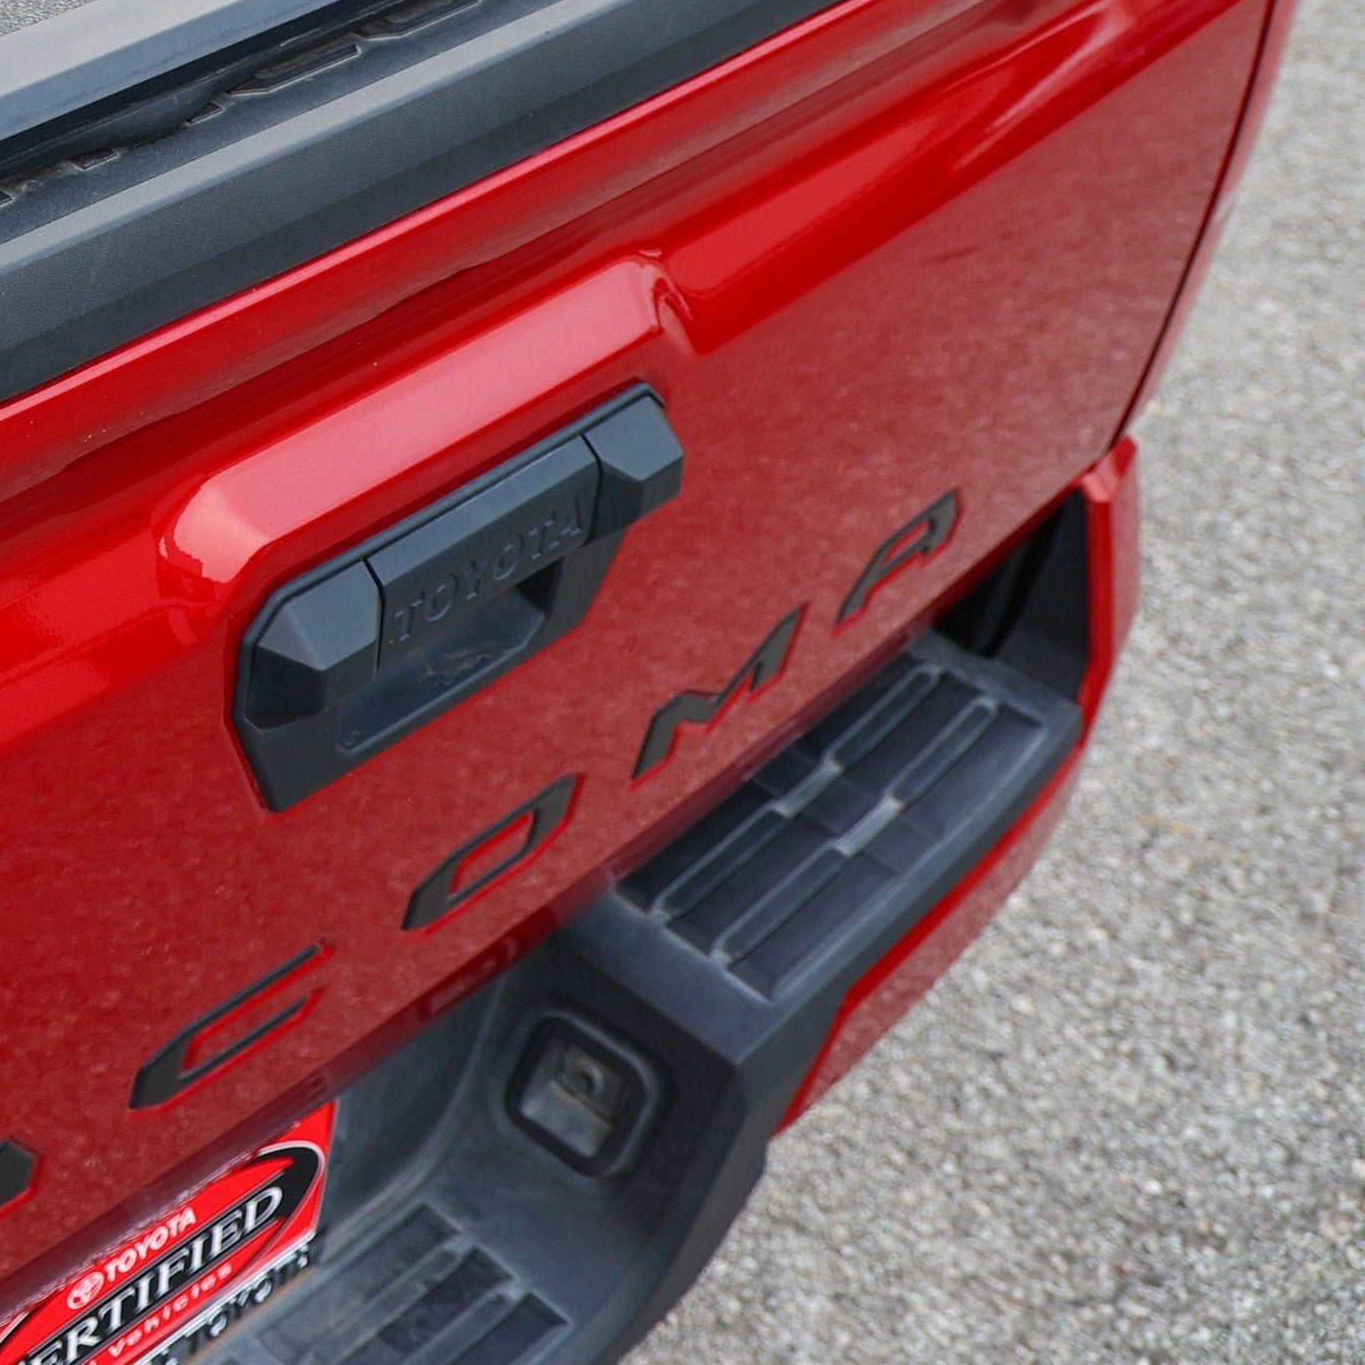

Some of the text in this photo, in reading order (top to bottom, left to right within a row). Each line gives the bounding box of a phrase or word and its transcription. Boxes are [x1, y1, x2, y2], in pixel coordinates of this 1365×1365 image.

[394, 498, 584, 642] TOYOTA
[17, 1186, 283, 1365] ERTIFIED
[104, 1206, 197, 1283] TOYOTA
[107, 1262, 233, 1358] Vehicles
